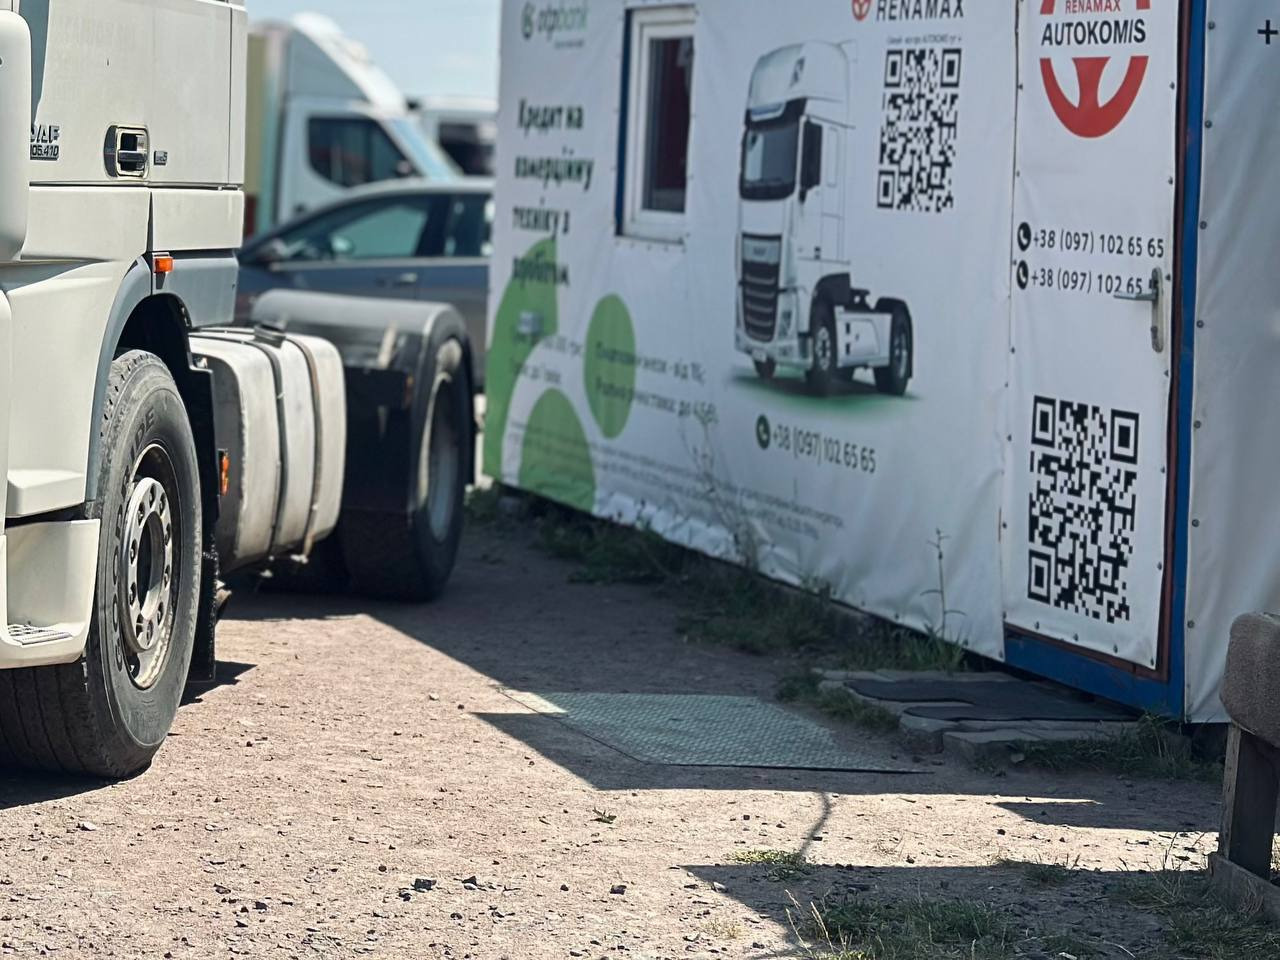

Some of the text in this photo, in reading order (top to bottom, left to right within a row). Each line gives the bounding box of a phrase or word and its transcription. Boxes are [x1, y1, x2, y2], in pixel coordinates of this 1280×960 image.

[1041, 18, 1146, 46] AUTOKOMIS
[1033, 229, 1164, 258] +38 (097) 102 65 65
[1031, 268, 1054, 287] +38
[1058, 268, 1092, 294] (097)
[1098, 274, 1121, 294] 102
[824, 437, 841, 464] 102
[844, 442, 858, 469] 65
[861, 446, 876, 474] 65
